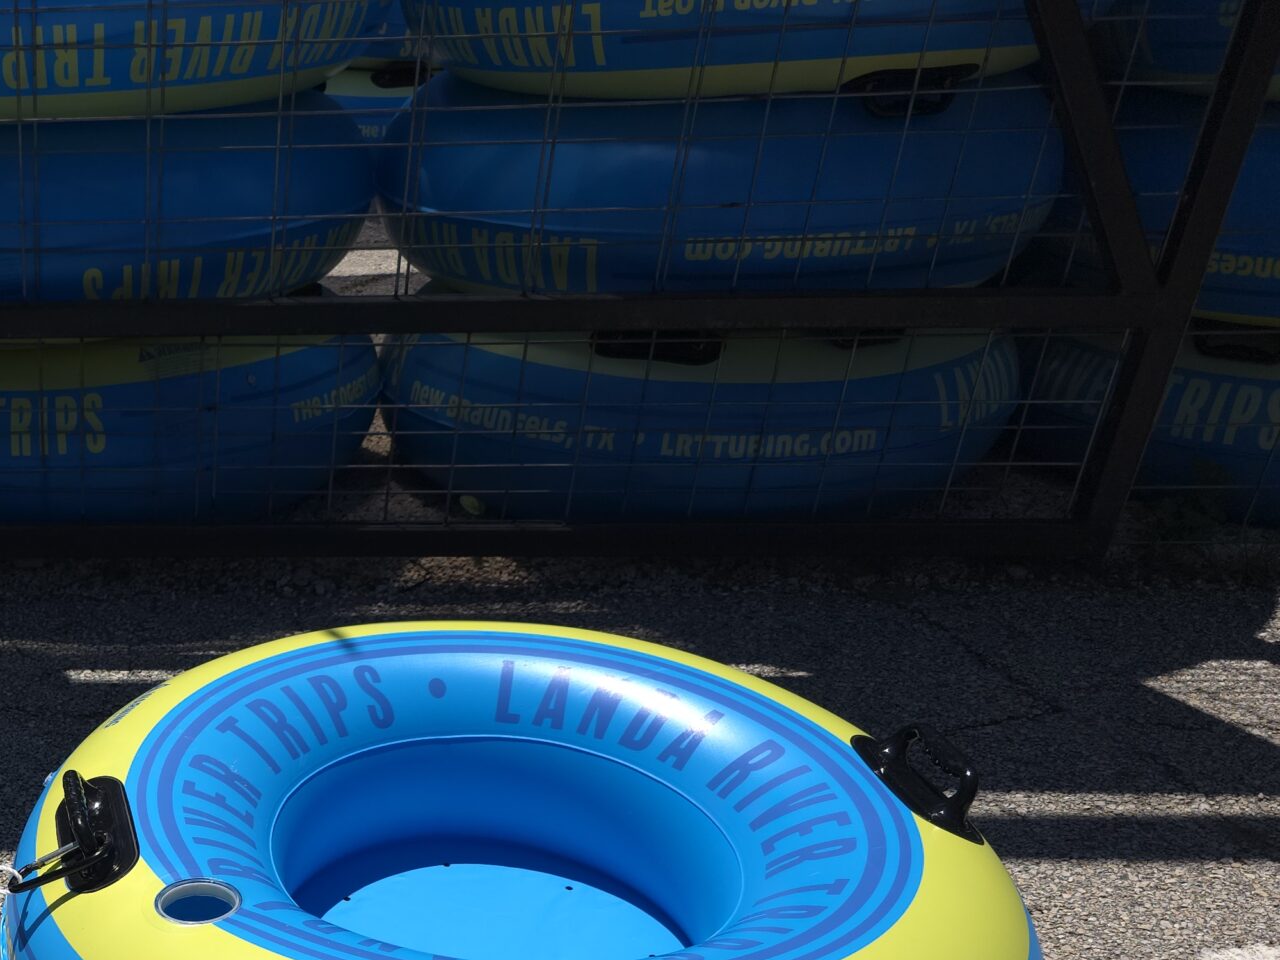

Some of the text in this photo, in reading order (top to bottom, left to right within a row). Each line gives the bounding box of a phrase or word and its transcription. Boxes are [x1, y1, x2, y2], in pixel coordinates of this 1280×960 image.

[129, 10, 264, 84] RIVER
[474, 3, 607, 67] LANDA
[471, 226, 599, 292] LANDA
[583, 425, 616, 450] TX
[215, 664, 396, 775] TRIPS
[494, 659, 724, 772] LANDA
[181, 753, 278, 887] RIVER
[705, 738, 858, 880] RIVER
